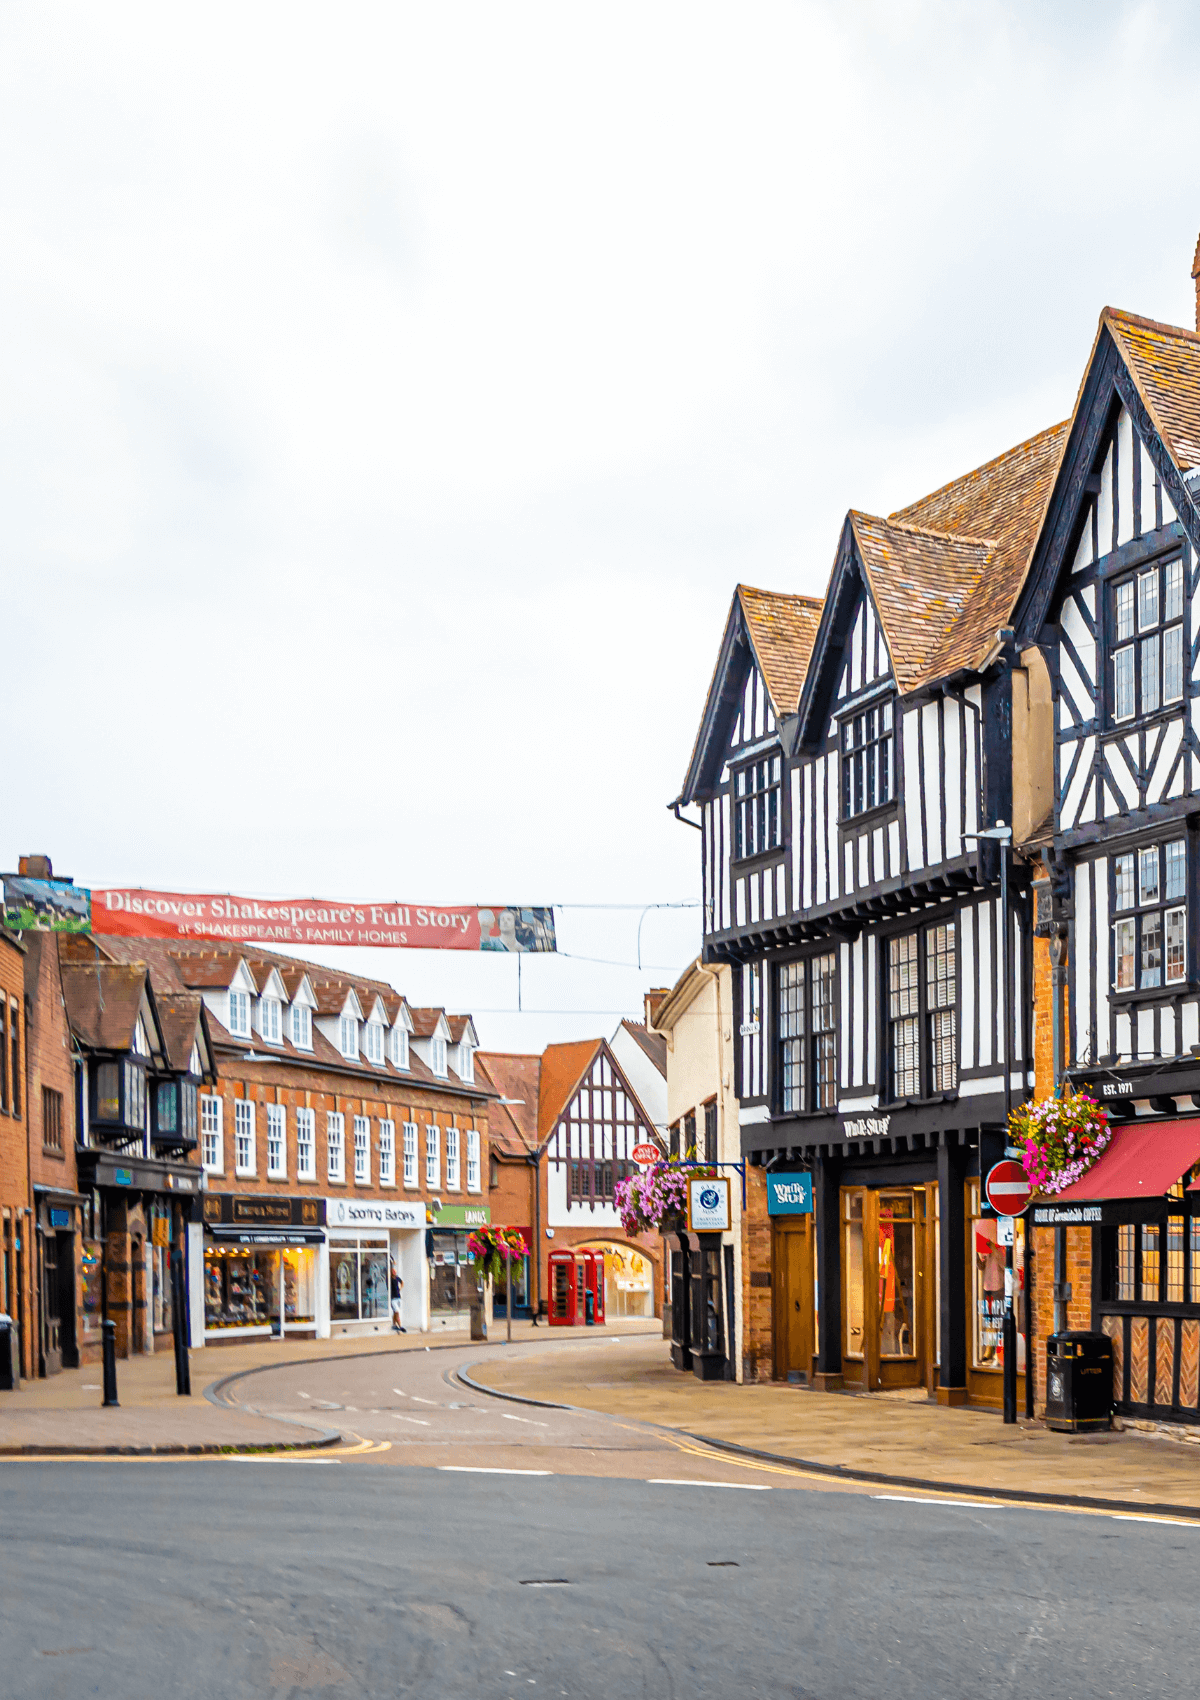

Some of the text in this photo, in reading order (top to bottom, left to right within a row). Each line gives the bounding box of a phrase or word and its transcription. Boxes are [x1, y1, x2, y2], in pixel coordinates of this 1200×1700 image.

[105, 891, 471, 934] Discover Shakespeare's Full Story
[178, 922, 408, 944] at SHAKESPEARE'S FAMILY HOMES
[1103, 1082, 1133, 1096] EST. 1971
[348, 1206, 382, 1221] Sporting
